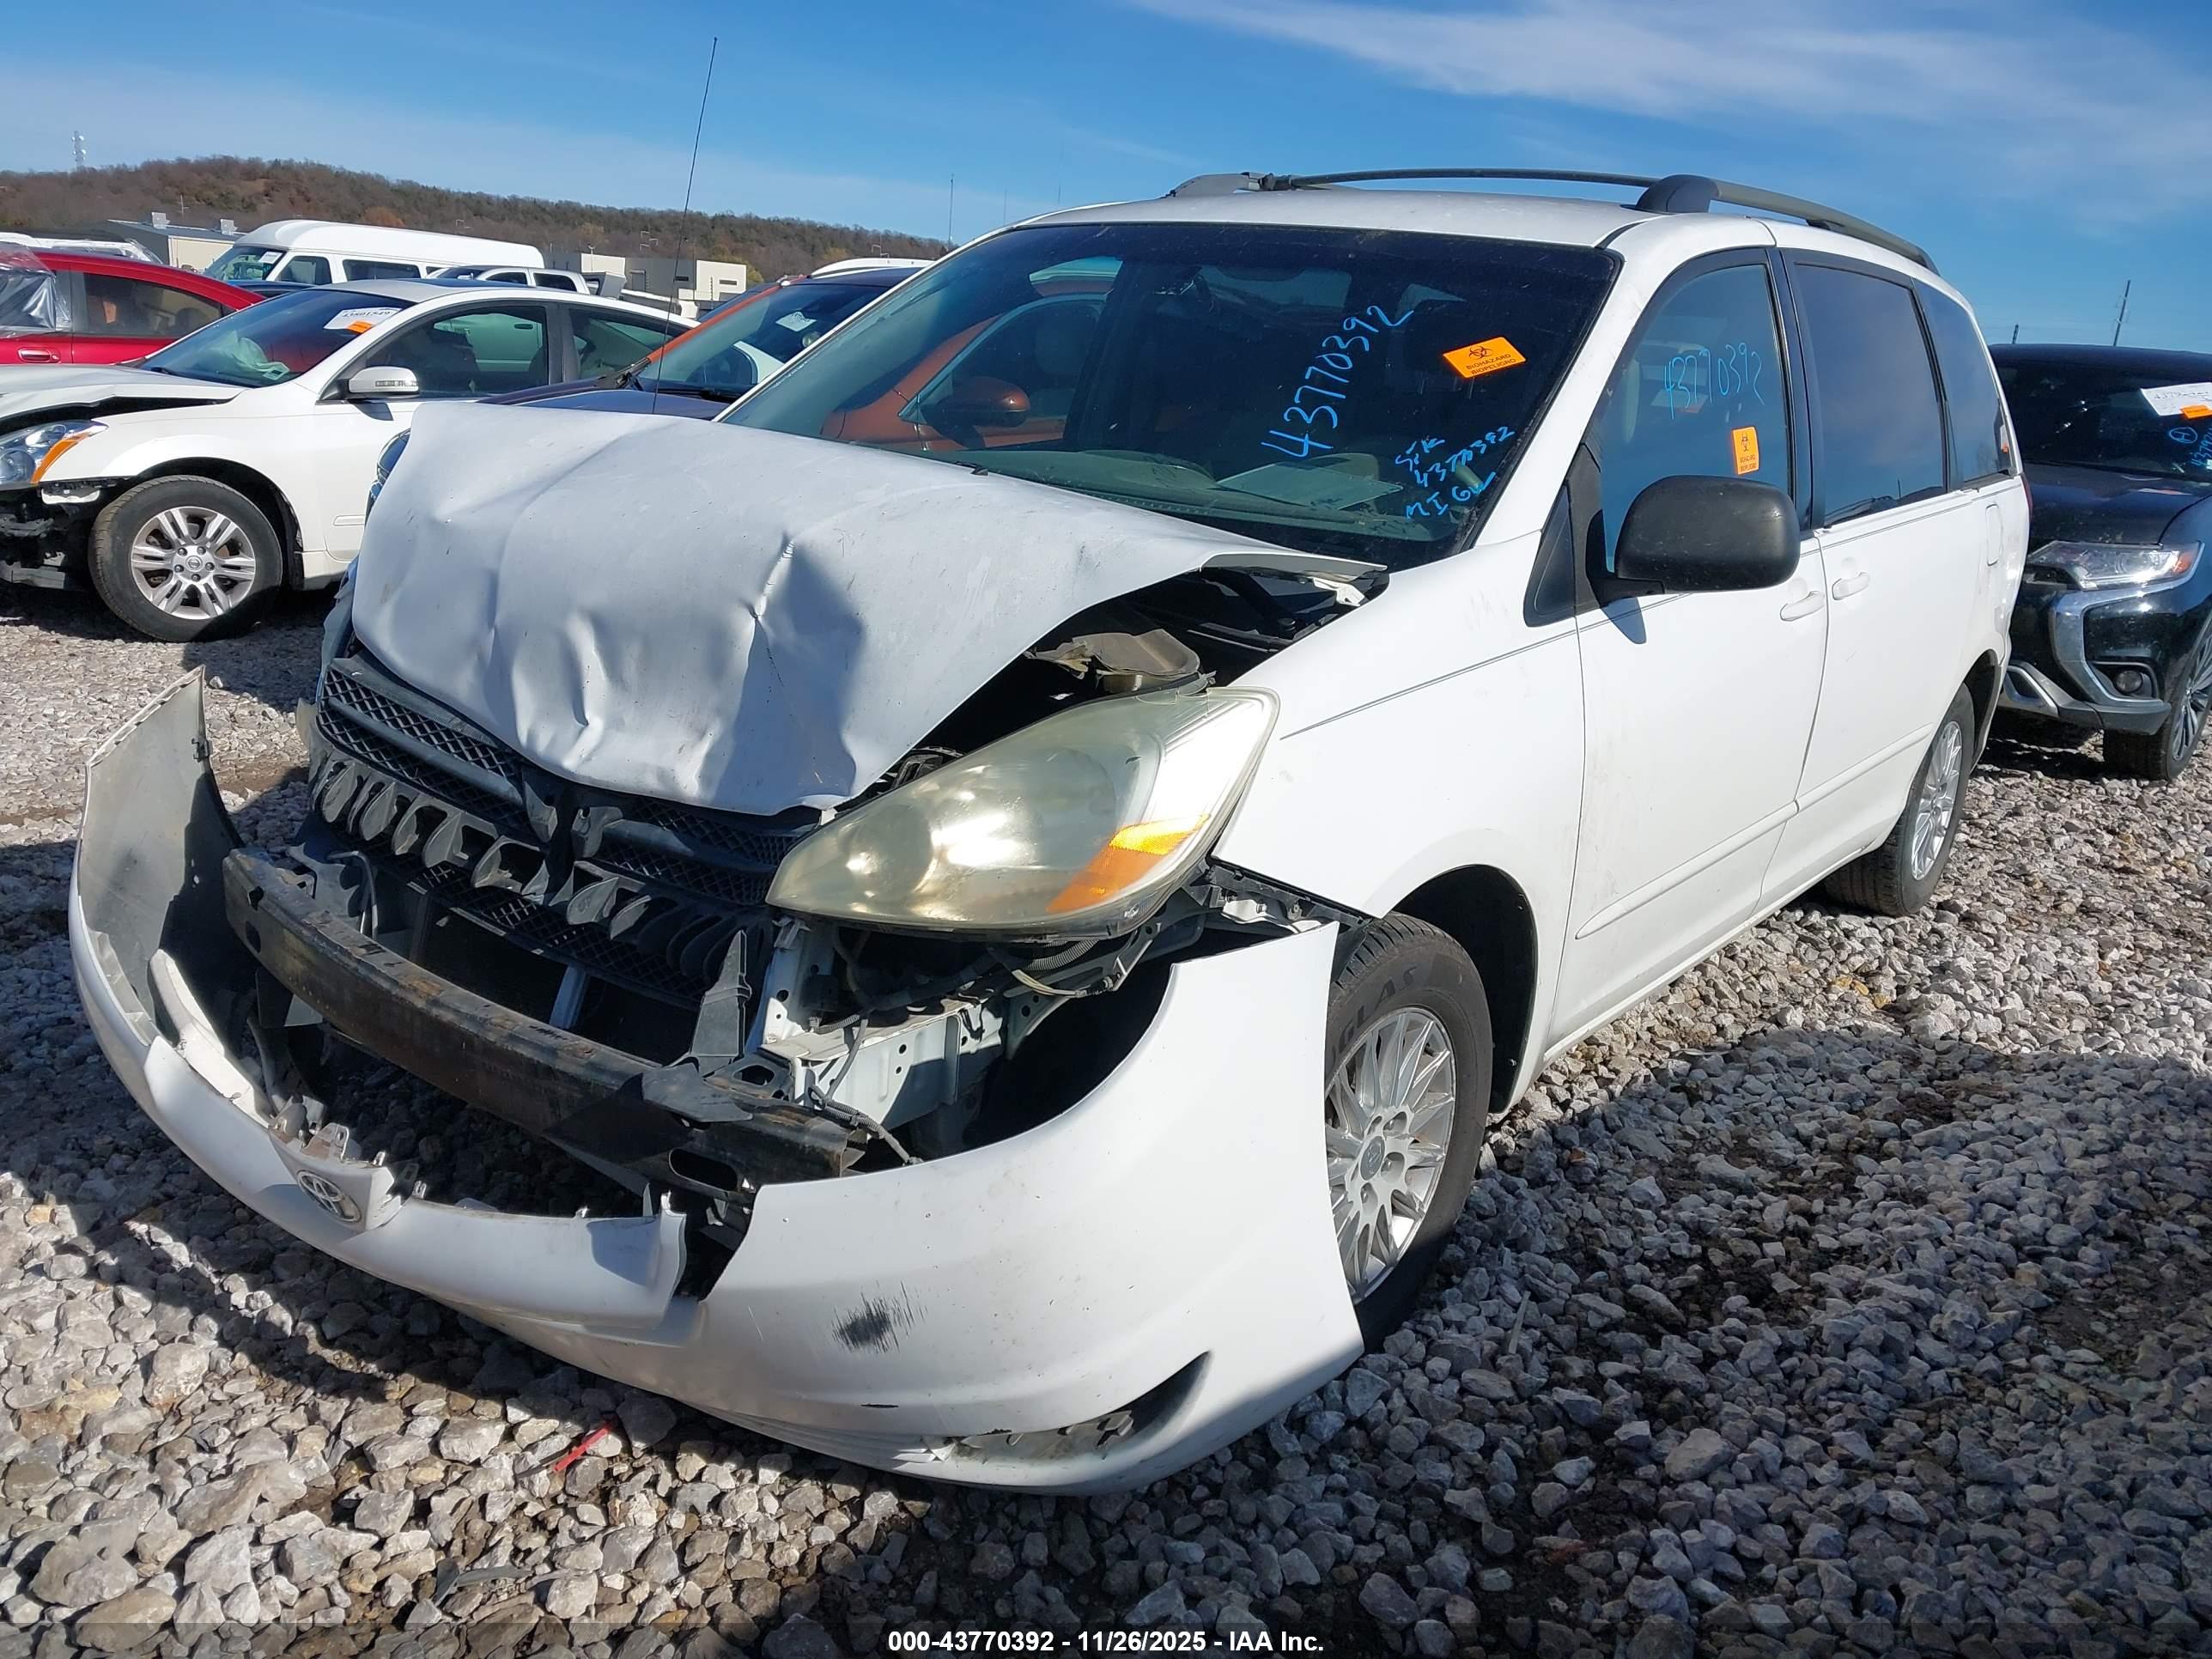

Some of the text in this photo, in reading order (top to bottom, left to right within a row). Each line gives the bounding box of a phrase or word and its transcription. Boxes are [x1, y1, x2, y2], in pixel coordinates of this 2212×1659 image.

[1260, 305, 1415, 458] 43770392
[1465, 353, 1511, 370] BIOHAZARD
[1470, 358, 1516, 375] BIOPELIGRO
[1664, 342, 1765, 420] 43770392
